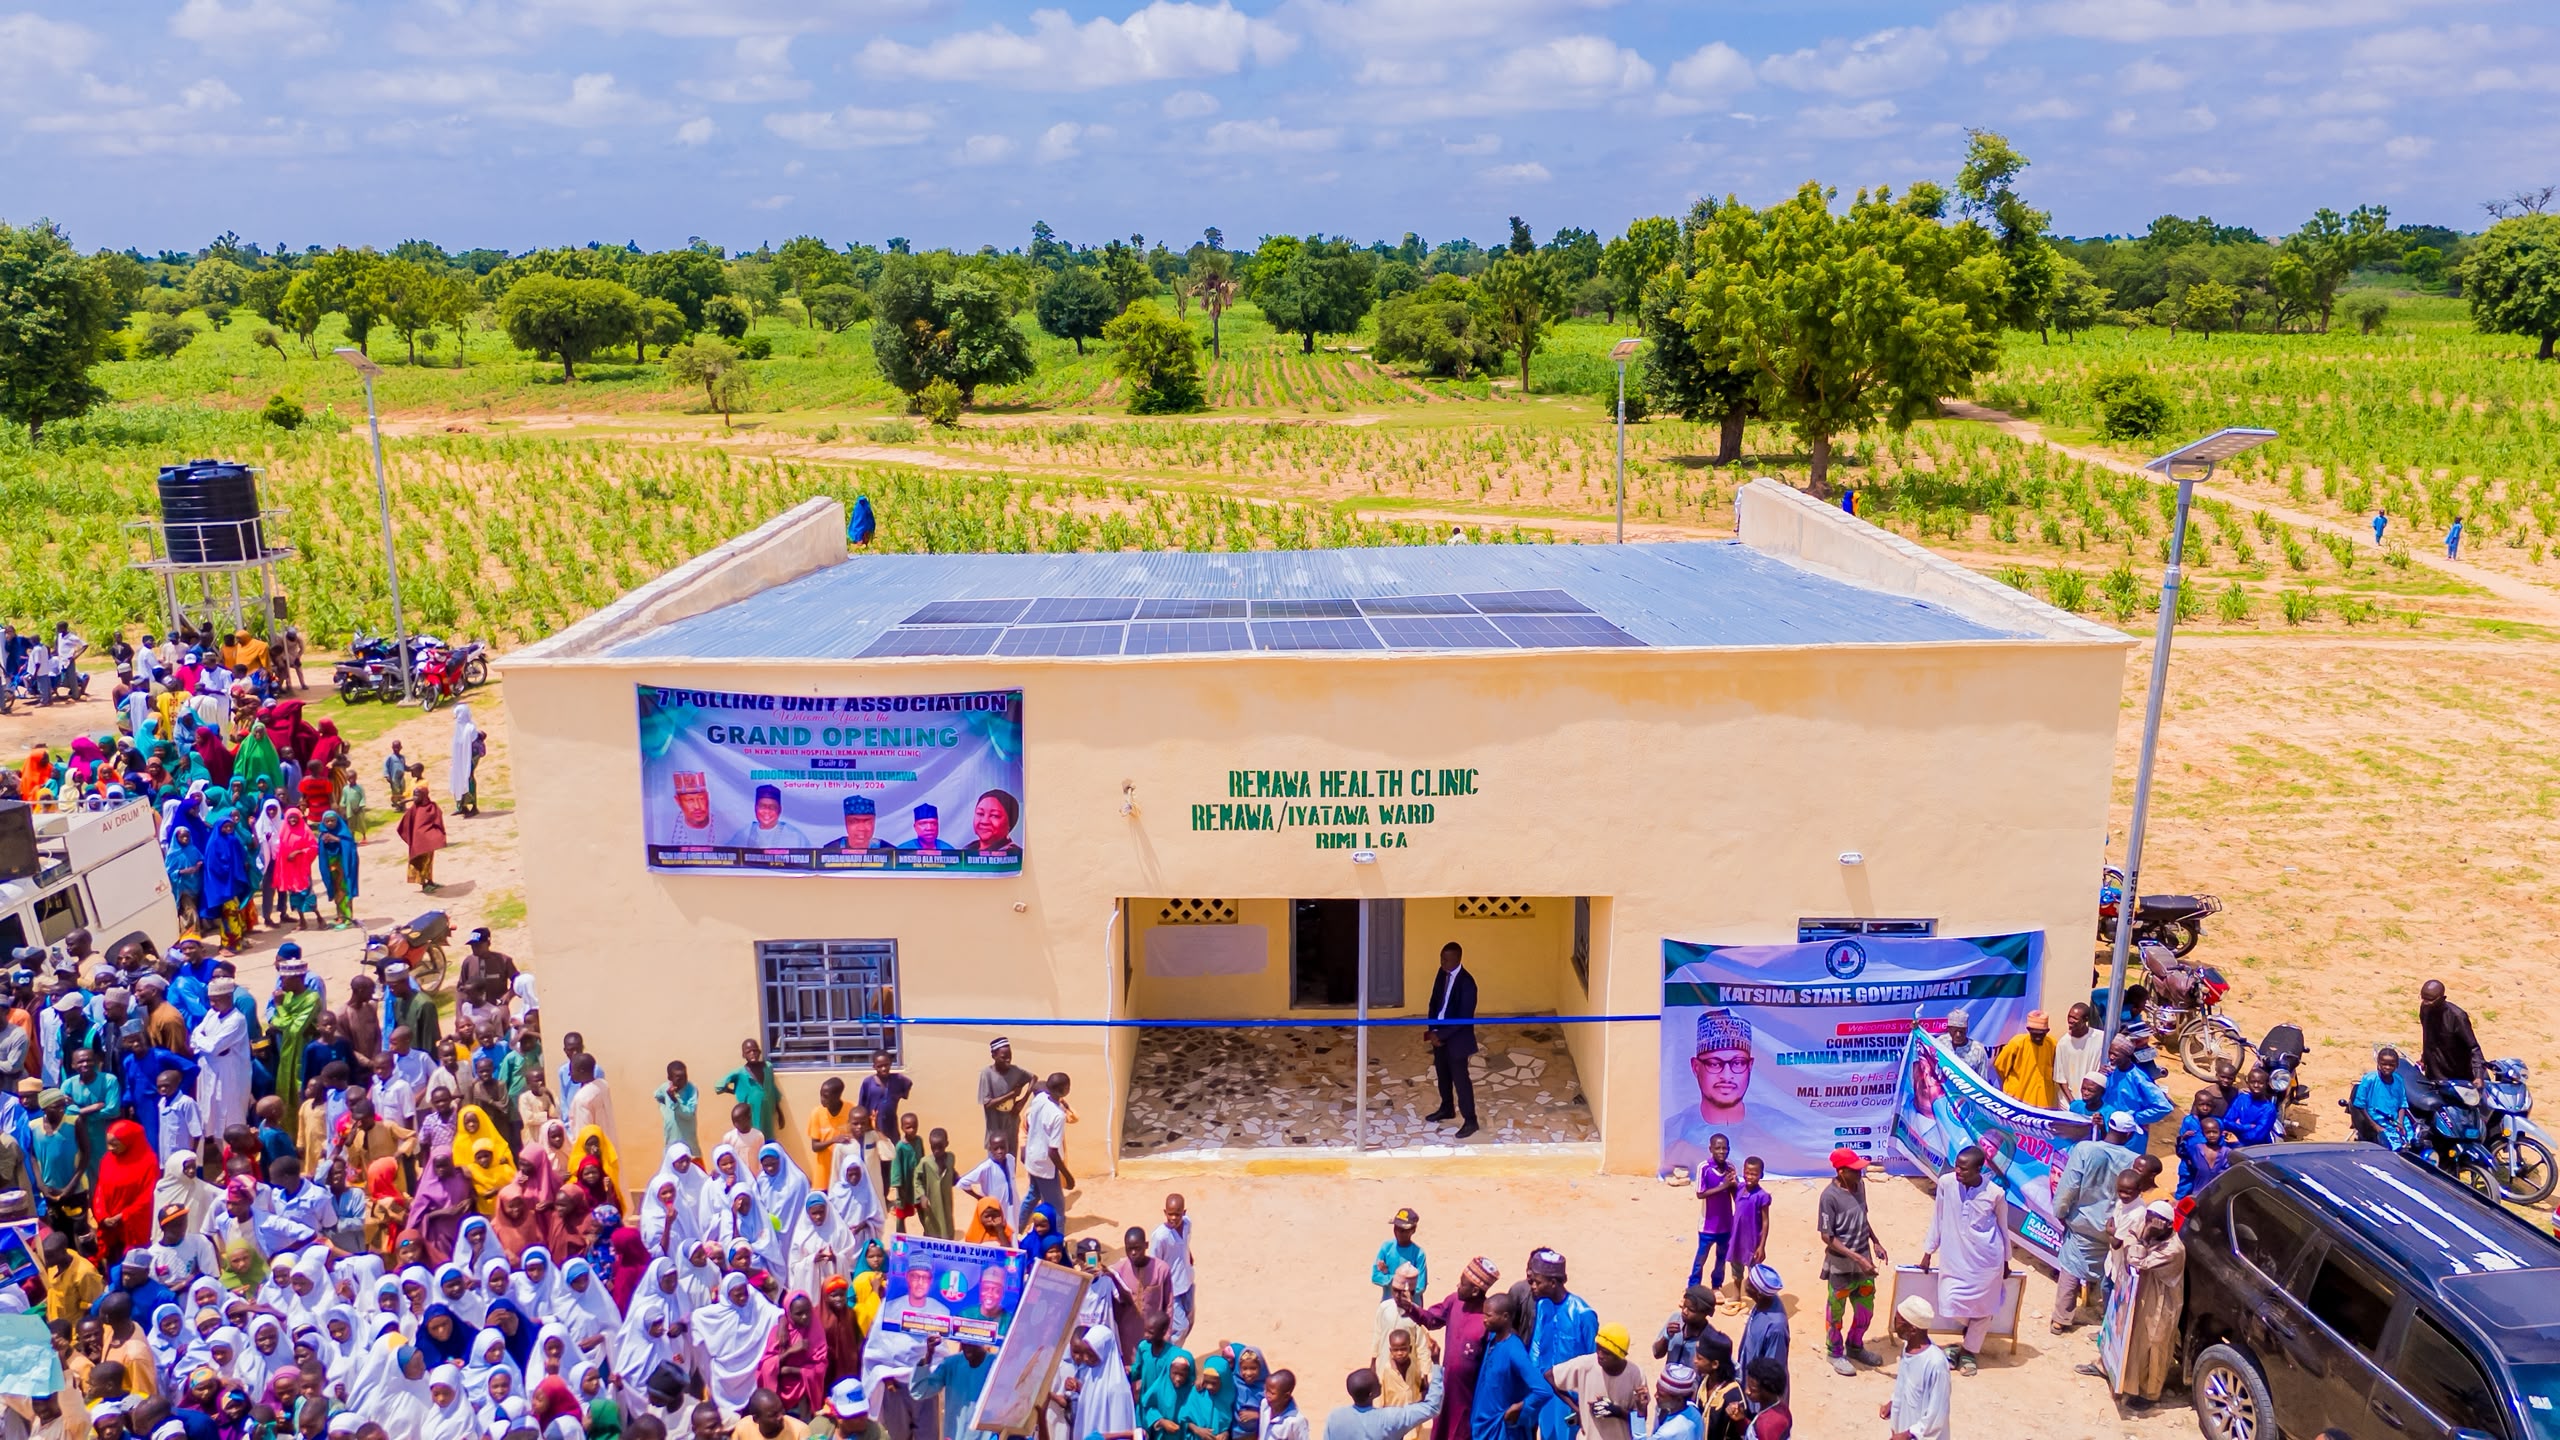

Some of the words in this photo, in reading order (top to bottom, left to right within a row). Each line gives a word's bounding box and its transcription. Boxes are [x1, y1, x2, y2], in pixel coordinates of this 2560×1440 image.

[658, 690, 670, 707] 7
[677, 691, 775, 709] POLLING
[781, 695, 838, 712] UNIT
[845, 694, 1007, 712] ASSOCIATION
[706, 725, 812, 746] GRAND
[822, 726, 959, 748] OPENING
[754, 748, 778, 756] NEWLY
[780, 748, 799, 756] BUILT
[800, 749, 833, 757] HOSPITAL
[897, 750, 921, 758] CLINIC)
[818, 759, 836, 768] Built
[838, 759, 849, 769] By
[783, 781, 820, 790] Saturday
[823, 781, 841, 789] 18th
[865, 781, 885, 789] 2026
[1228, 770, 1311, 797] REMAWA
[1320, 769, 1402, 797] HEALTH
[1411, 768, 1479, 797] CLINIC
[115, 807, 140, 827] DRUM
[1379, 803, 1435, 825] WARD
[1316, 832, 1357, 849] RIMI
[1719, 986, 1796, 1004] KATSINA
[1800, 986, 1851, 1004] STATE
[1855, 979, 1972, 1004] GOVERNMENT
[1848, 1021, 1897, 1033] Welcomes
[1932, 1020, 1947, 1030] the
[1826, 1034, 1909, 1049] COMMISSION
[1776, 1050, 1840, 1066] REMAWA
[1851, 1073, 1866, 1084] By
[1867, 1072, 1884, 1082] His
[1797, 1086, 1823, 1098] MAL.
[1824, 1084, 1858, 1097] DIKKO
[1809, 1098, 1858, 1108] Executive
[1968, 1091, 2015, 1119] LOCAL
[2028, 1217, 2061, 1242] RADDA
[969, 1247, 996, 1259] ZUWA
